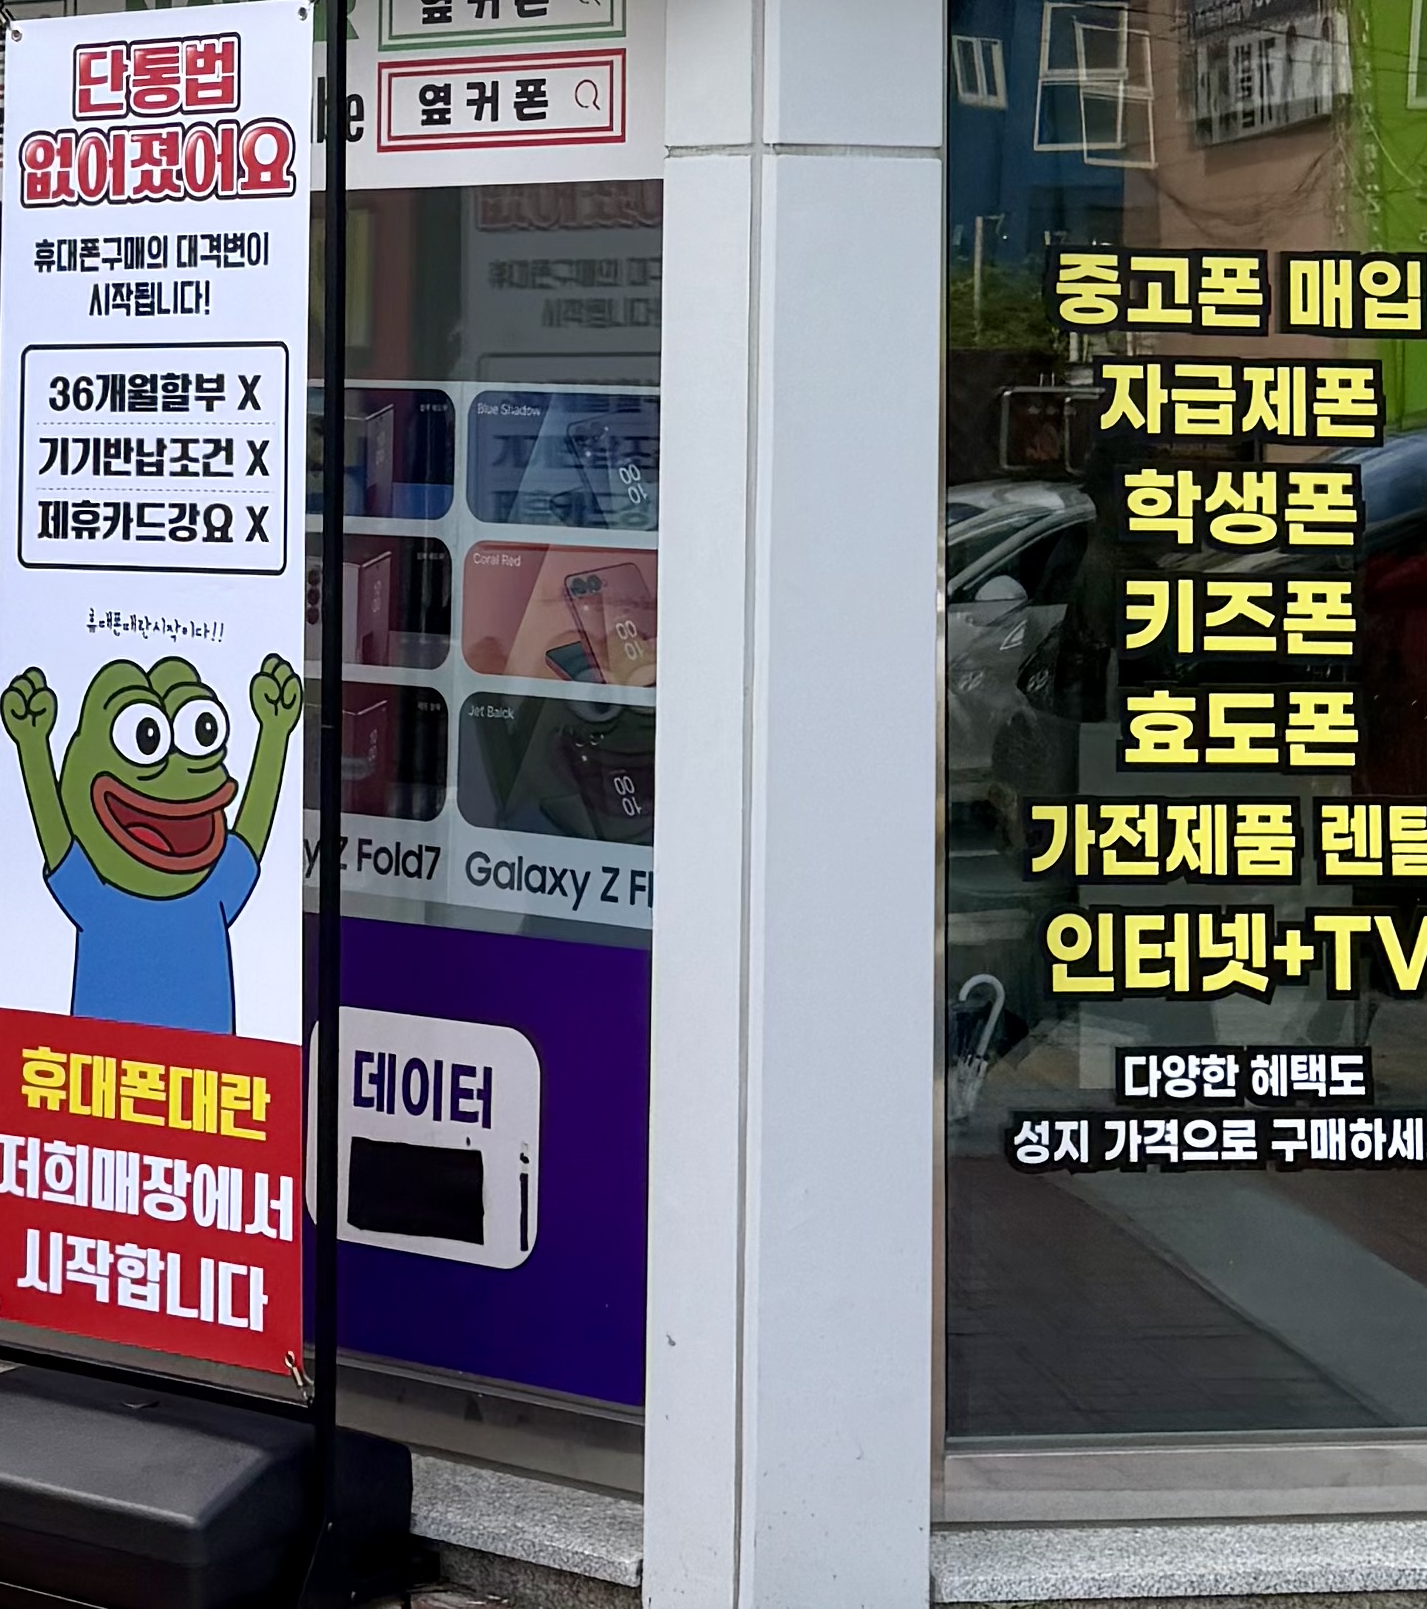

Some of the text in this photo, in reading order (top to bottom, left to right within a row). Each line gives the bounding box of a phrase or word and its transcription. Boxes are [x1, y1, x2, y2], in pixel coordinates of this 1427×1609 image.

[76, 37, 238, 117] 단통법
[22, 124, 295, 206] 없어졌어요
[34, 232, 270, 274] 휴대폰구매의 대격변이
[88, 280, 212, 317] 시작됩니다!
[1055, 252, 1422, 331] 중고폰 매입
[49, 372, 262, 414] 36개월할부 X
[477, 403, 541, 417] Blue Shadow
[1099, 363, 1378, 439] 자급제폰
[38, 436, 270, 479] 기기반납조건 X
[37, 500, 270, 544] 제휴카드강요 X
[1124, 468, 1358, 546] 학생폰
[474, 553, 521, 567] Coral Red
[1125, 579, 1357, 655] 키즈폰
[468, 705, 485, 718] Jet
[1124, 690, 1359, 766] 효도폰
[357, 839, 441, 881] Fold7
[1030, 803, 1296, 878] 가전제품
[465, 851, 591, 912] Galaxy
[600, 866, 620, 904] Z
[20, 1048, 271, 1142] 휴대폰대란
[352, 1050, 493, 1130] 데이터
[1124, 1054, 1366, 1097] 다양한 혜택도
[1013, 1120, 1089, 1164] 성지
[1104, 1119, 1258, 1163] 가격으로
[17, 1230, 269, 1334] 시작합니다
